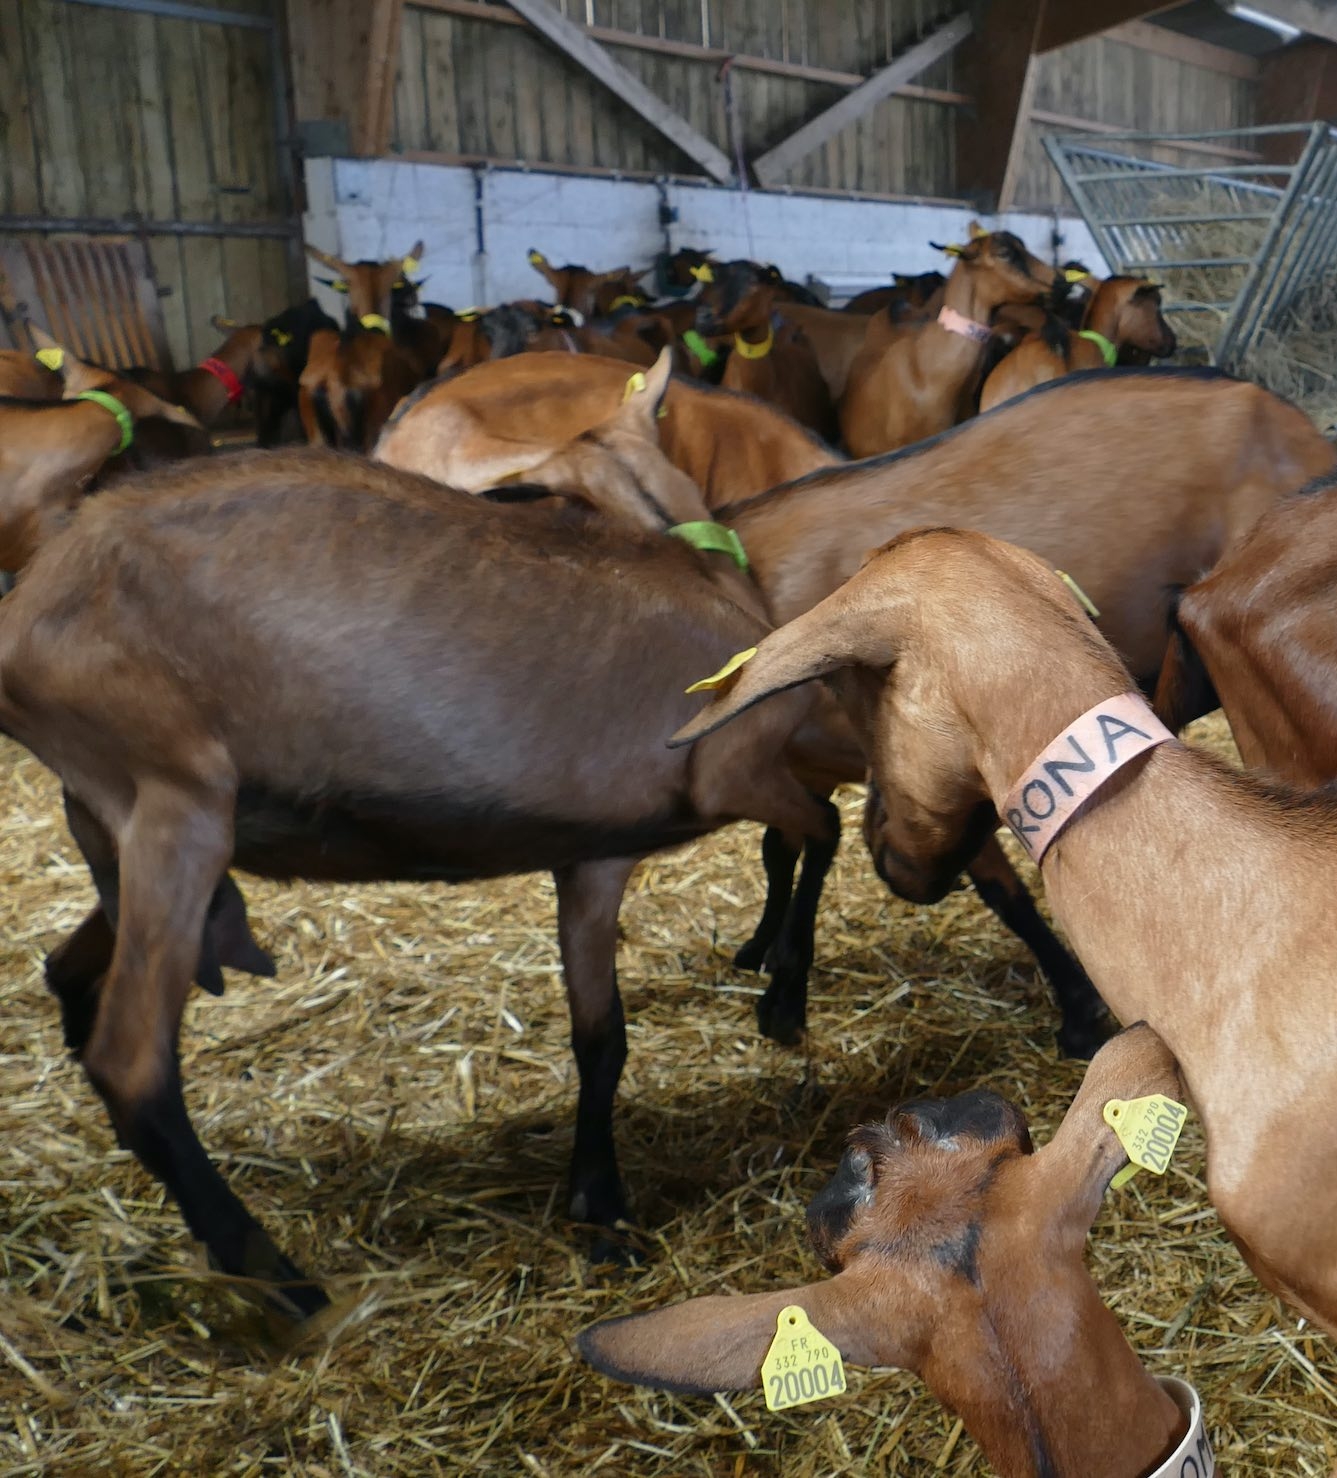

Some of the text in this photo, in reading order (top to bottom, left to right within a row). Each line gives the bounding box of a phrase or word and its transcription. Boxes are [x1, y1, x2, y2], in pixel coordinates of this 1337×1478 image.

[1132, 1101, 1159, 1151] 332 790
[1141, 1101, 1185, 1171] 20004
[775, 1346, 829, 1370] 332 790
[791, 1337, 809, 1351] FR
[769, 1360, 844, 1408] 20004
